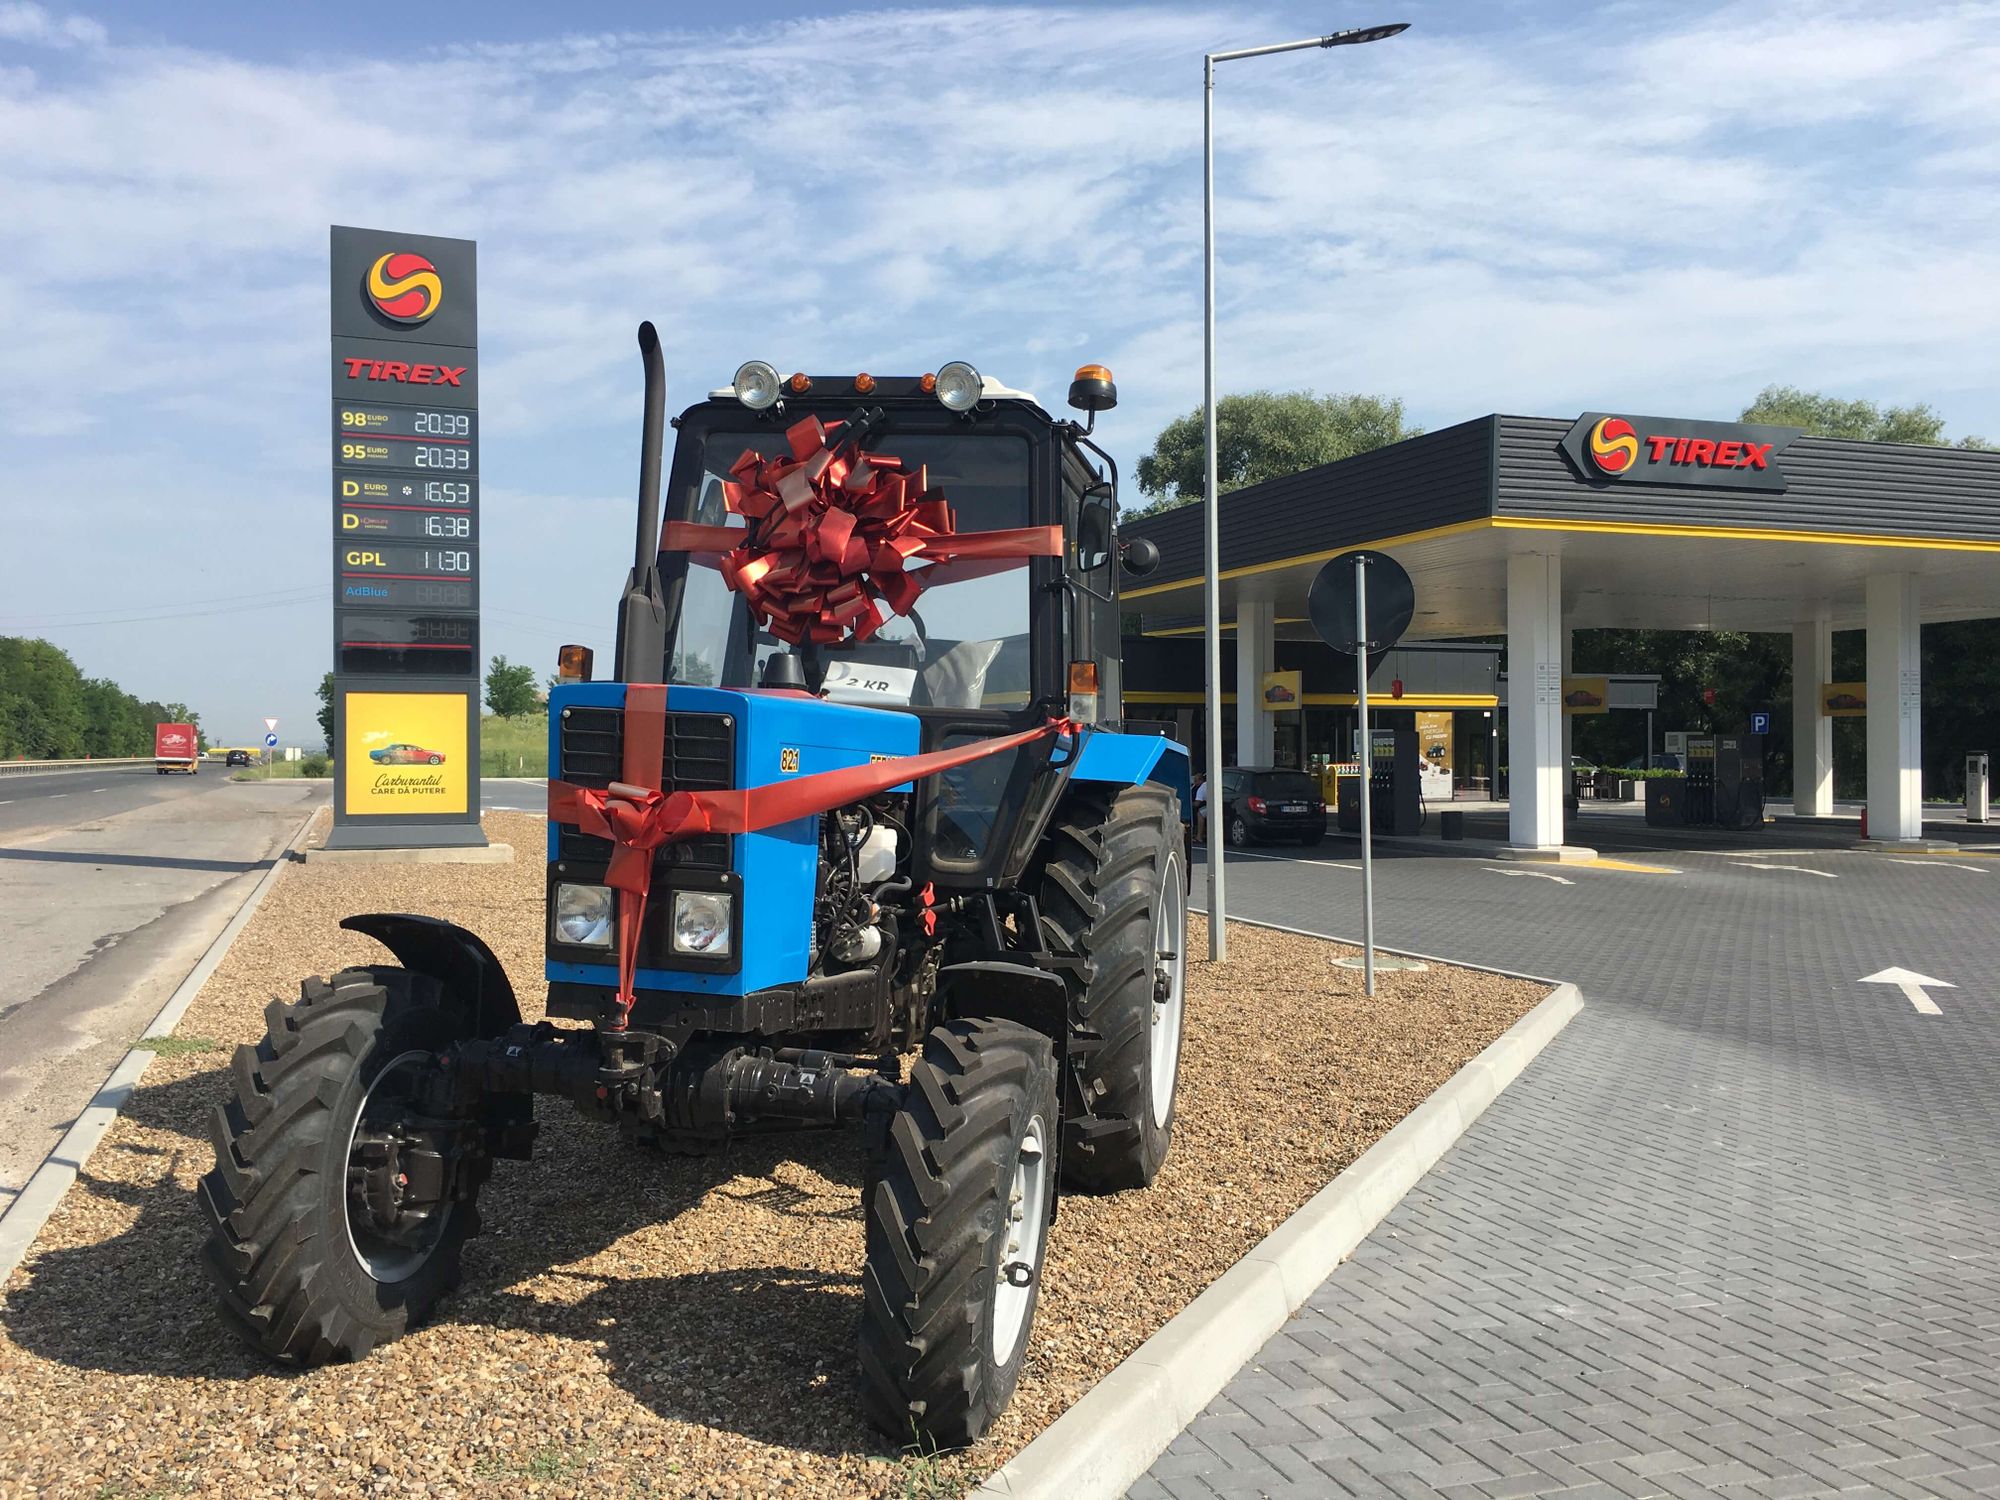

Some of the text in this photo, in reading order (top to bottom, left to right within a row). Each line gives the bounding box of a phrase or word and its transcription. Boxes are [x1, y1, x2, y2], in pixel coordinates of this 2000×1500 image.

[344, 358, 467, 386] TIREX
[342, 411, 389, 426] 98 EURO
[415, 412, 469, 435] 20.39
[342, 444, 388, 459] 95 EURO
[415, 446, 469, 469] 20.33
[1645, 435, 1773, 469] TIREX
[343, 480, 388, 496] D EURO
[425, 482, 470, 503] 16.53
[343, 513, 360, 529] D
[425, 516, 470, 537] 16.38
[346, 551, 386, 566] GPL
[425, 551, 470, 571] 11.30
[345, 586, 388, 597] AdBlue
[863, 680, 889, 692] KR
[1755, 716, 1766, 732] P
[374, 773, 443, 788] Carburantul
